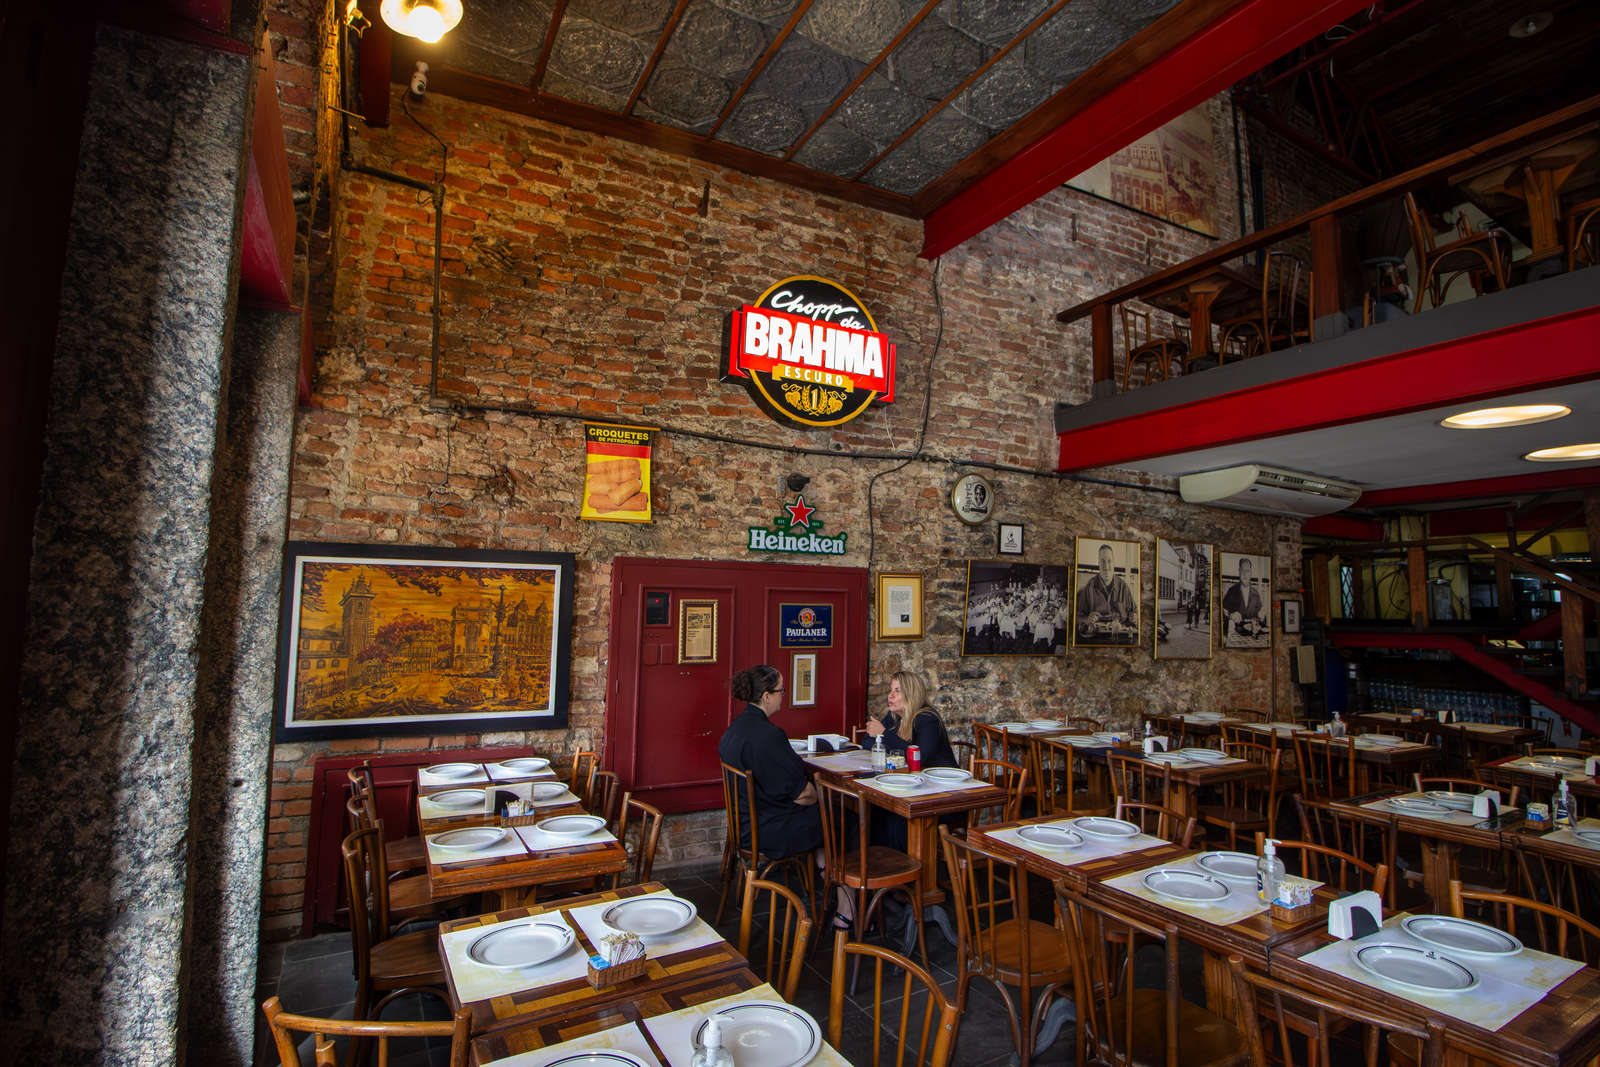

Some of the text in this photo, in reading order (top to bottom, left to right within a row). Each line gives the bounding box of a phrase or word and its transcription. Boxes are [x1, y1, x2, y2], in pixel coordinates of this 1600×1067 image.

[771, 290, 865, 330] Chopp da
[744, 312, 884, 378] BRAHMA
[784, 366, 844, 386] ESCURO
[589, 428, 649, 441] CROQUETES
[750, 529, 845, 554] Heineken
[786, 628, 827, 637] PAULANER
